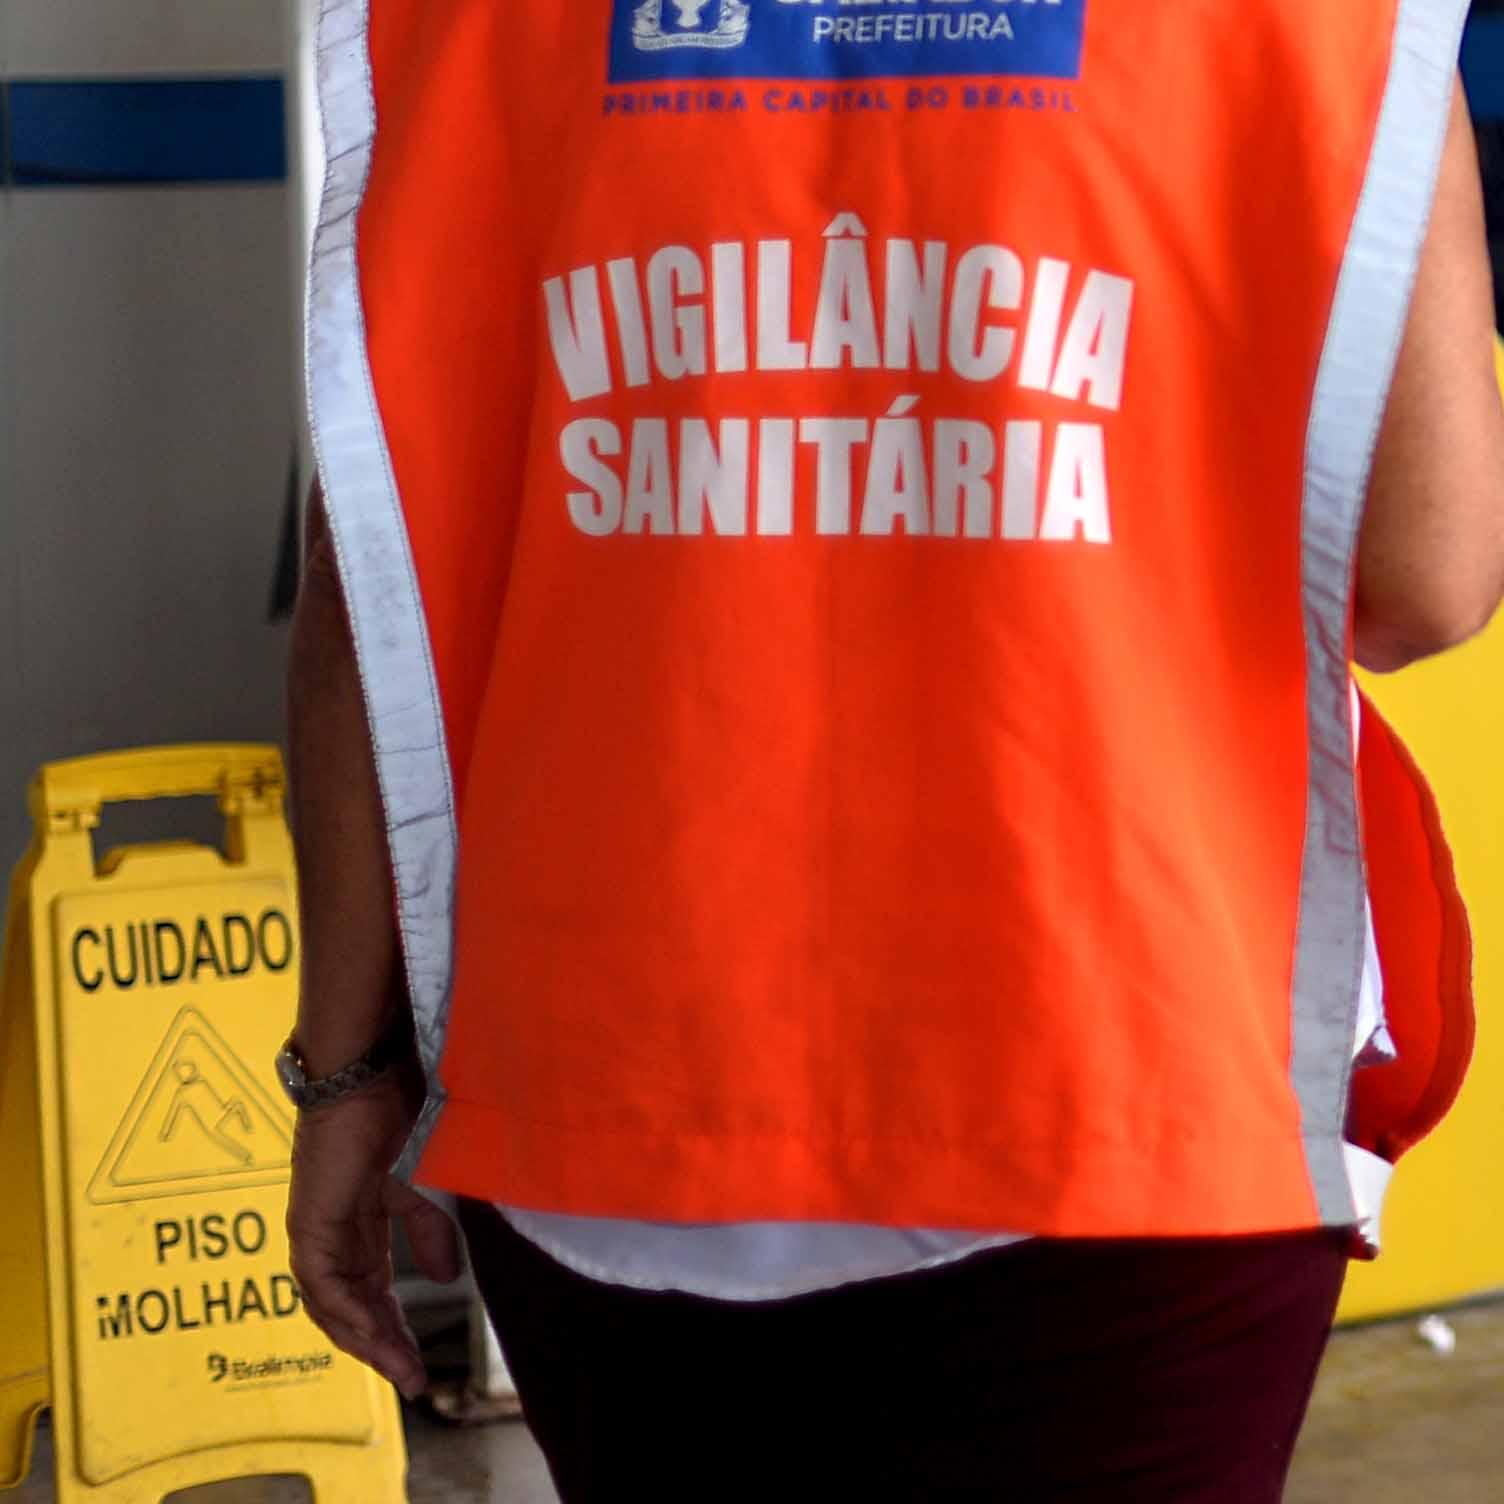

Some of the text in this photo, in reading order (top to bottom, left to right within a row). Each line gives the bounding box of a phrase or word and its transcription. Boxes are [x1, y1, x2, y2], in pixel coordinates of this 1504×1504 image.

[812, 11, 1014, 45] PREFEITURA
[601, 85, 1079, 116] PRIMEIRA CAPITAL DO BRASIL
[542, 211, 1135, 412] VIGILÂNCIA
[560, 394, 1112, 545] SANITÁRIA
[72, 909, 293, 993] CUIDADO
[155, 1210, 266, 1264] PISO
[97, 1273, 302, 1341] MOLHAD
